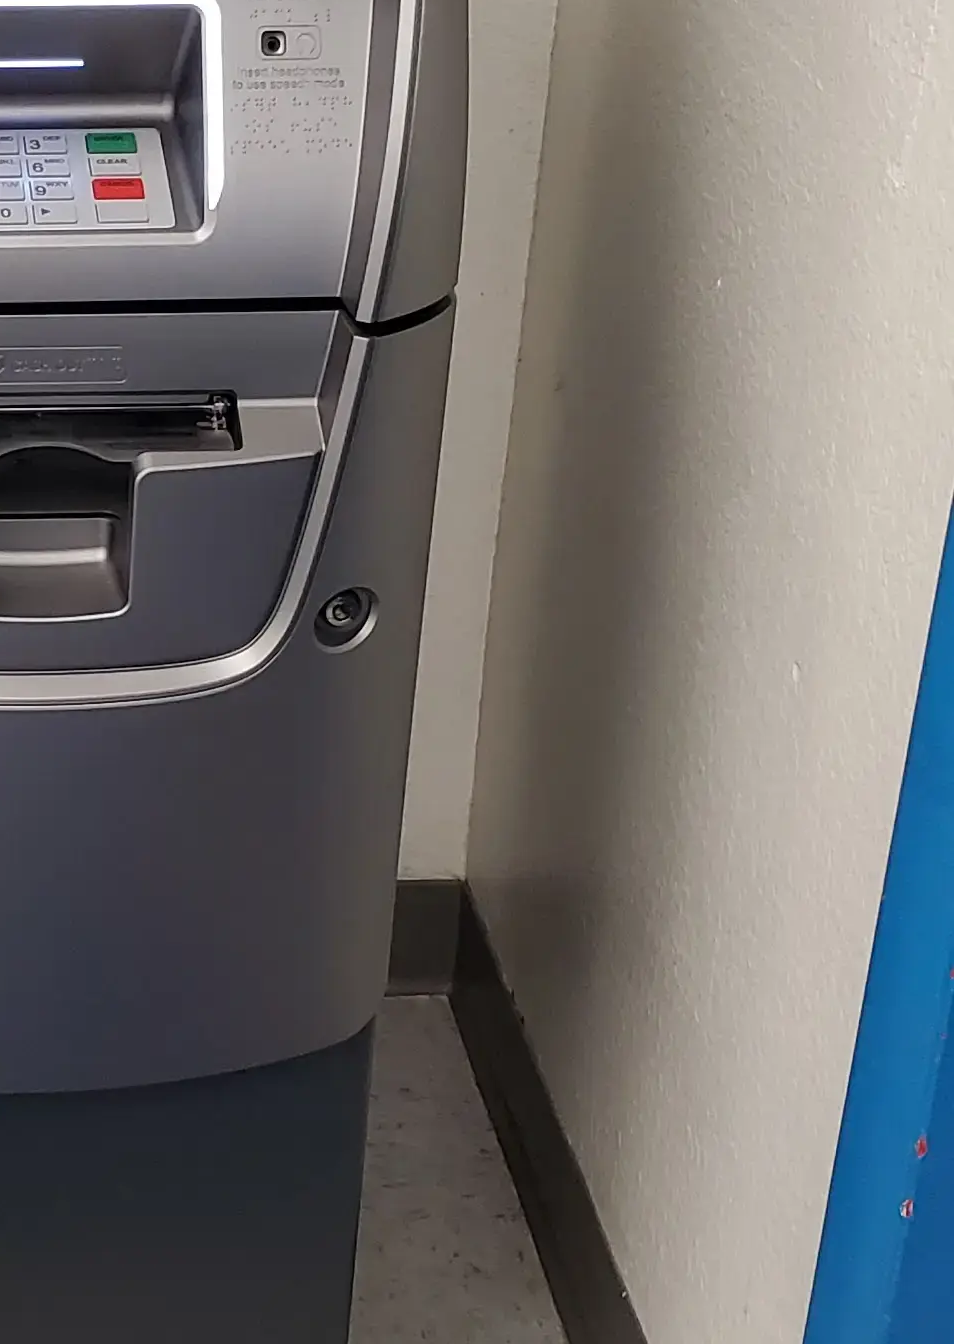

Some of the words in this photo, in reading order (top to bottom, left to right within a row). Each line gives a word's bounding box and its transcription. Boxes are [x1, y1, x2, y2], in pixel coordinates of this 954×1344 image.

[237, 66, 268, 78] Insert
[271, 66, 341, 79] headphones
[232, 79, 243, 90] to
[246, 80, 267, 90] use
[270, 79, 310, 91] speech
[313, 79, 346, 89] mode
[29, 138, 41, 150] 3
[32, 162, 44, 173] 6
[35, 185, 47, 197] 9
[0, 208, 12, 219] 0
